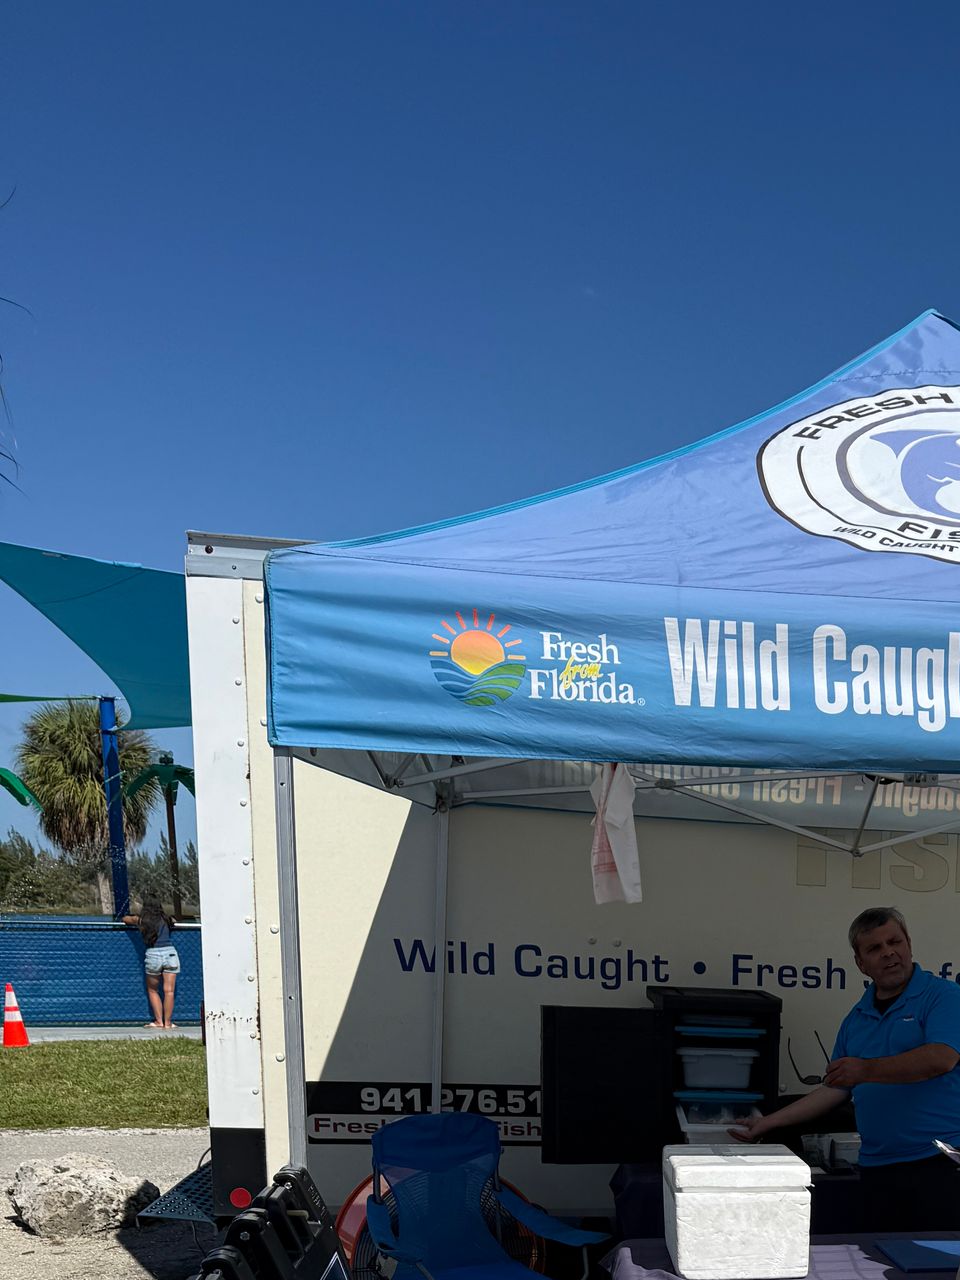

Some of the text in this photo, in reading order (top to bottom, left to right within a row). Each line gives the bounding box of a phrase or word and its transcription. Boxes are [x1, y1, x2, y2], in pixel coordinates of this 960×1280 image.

[794, 391, 954, 441] FRESH
[832, 524, 875, 539] WILD
[878, 535, 959, 554] CAUGHT
[540, 631, 622, 665] Fresh
[664, 616, 791, 711] Wild
[559, 654, 604, 689] from
[393, 938, 496, 975] Wild
[514, 943, 670, 991] Caught
[732, 954, 846, 989] Fresh
